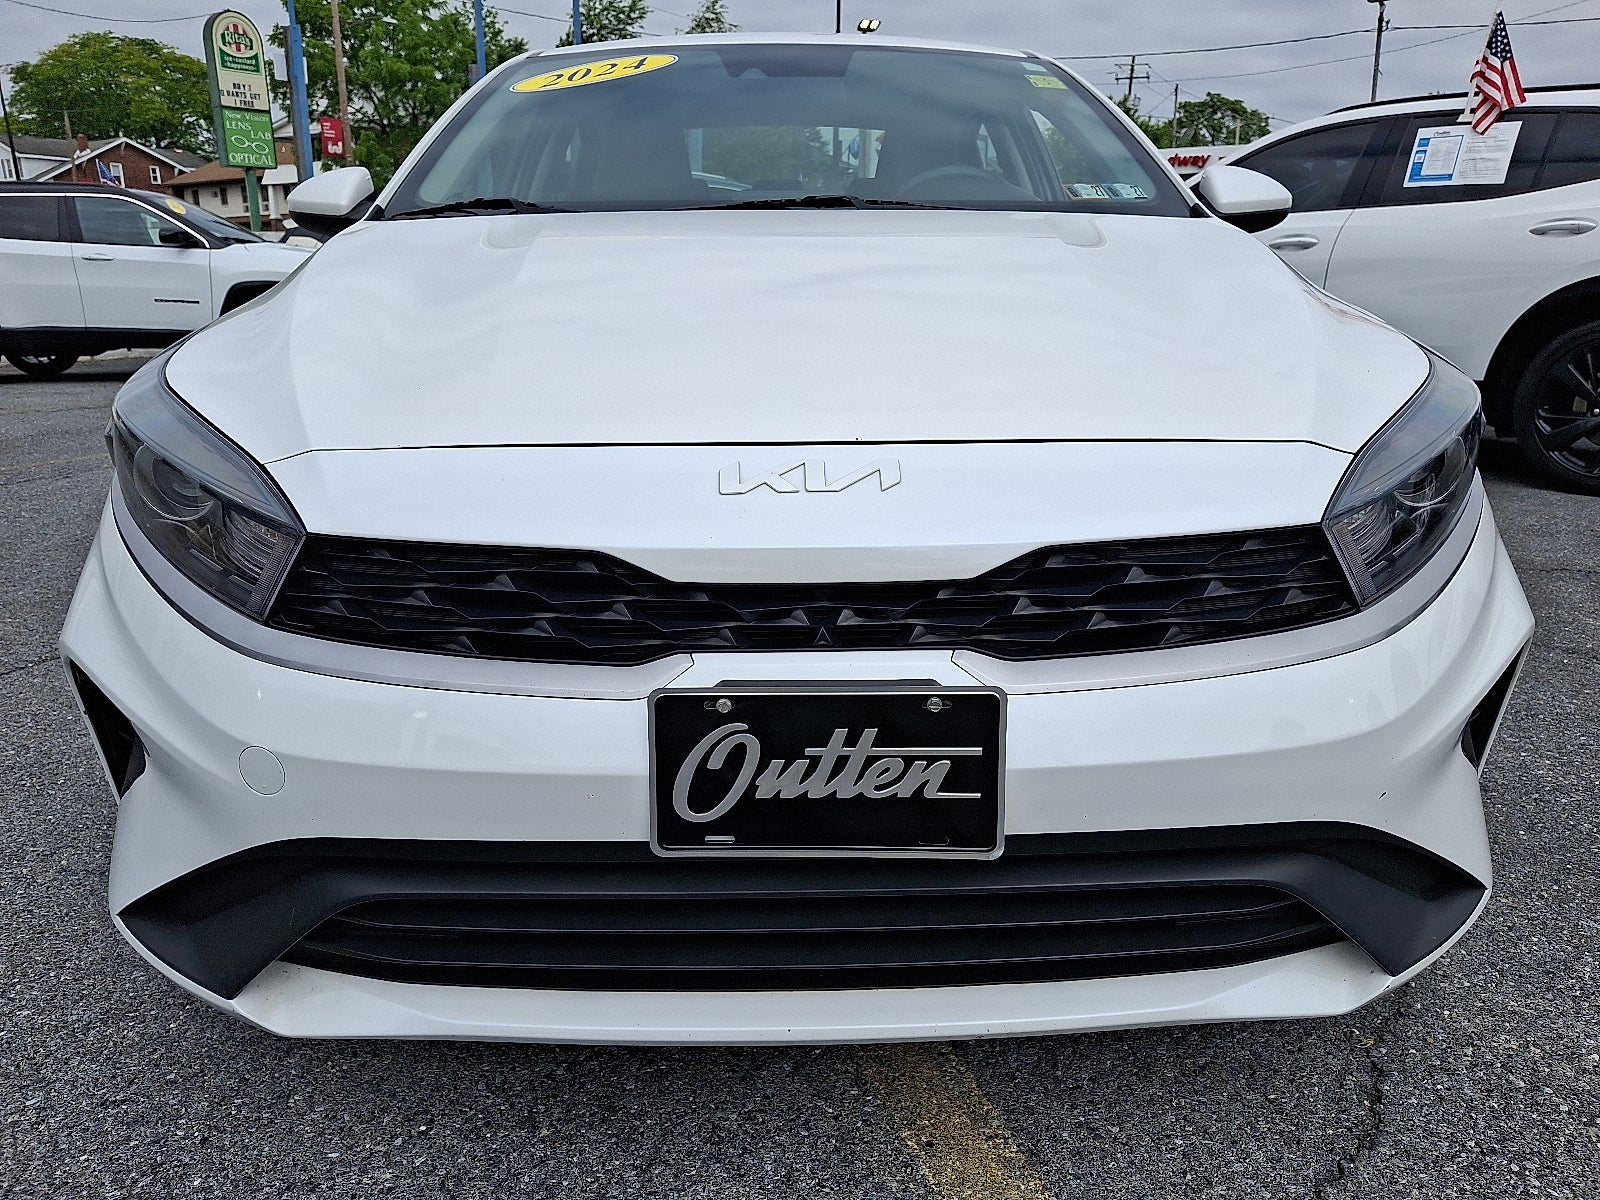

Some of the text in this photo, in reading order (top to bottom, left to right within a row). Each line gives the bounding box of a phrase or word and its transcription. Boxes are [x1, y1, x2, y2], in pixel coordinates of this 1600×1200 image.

[224, 30, 251, 46] Rita's
[539, 56, 649, 89] 2024
[240, 99, 255, 107] FREE
[226, 120, 252, 131] LENS
[250, 130, 272, 140] LAB
[229, 152, 274, 166] OPTICAL
[718, 459, 902, 496] KIA
[672, 722, 983, 824] Outten
